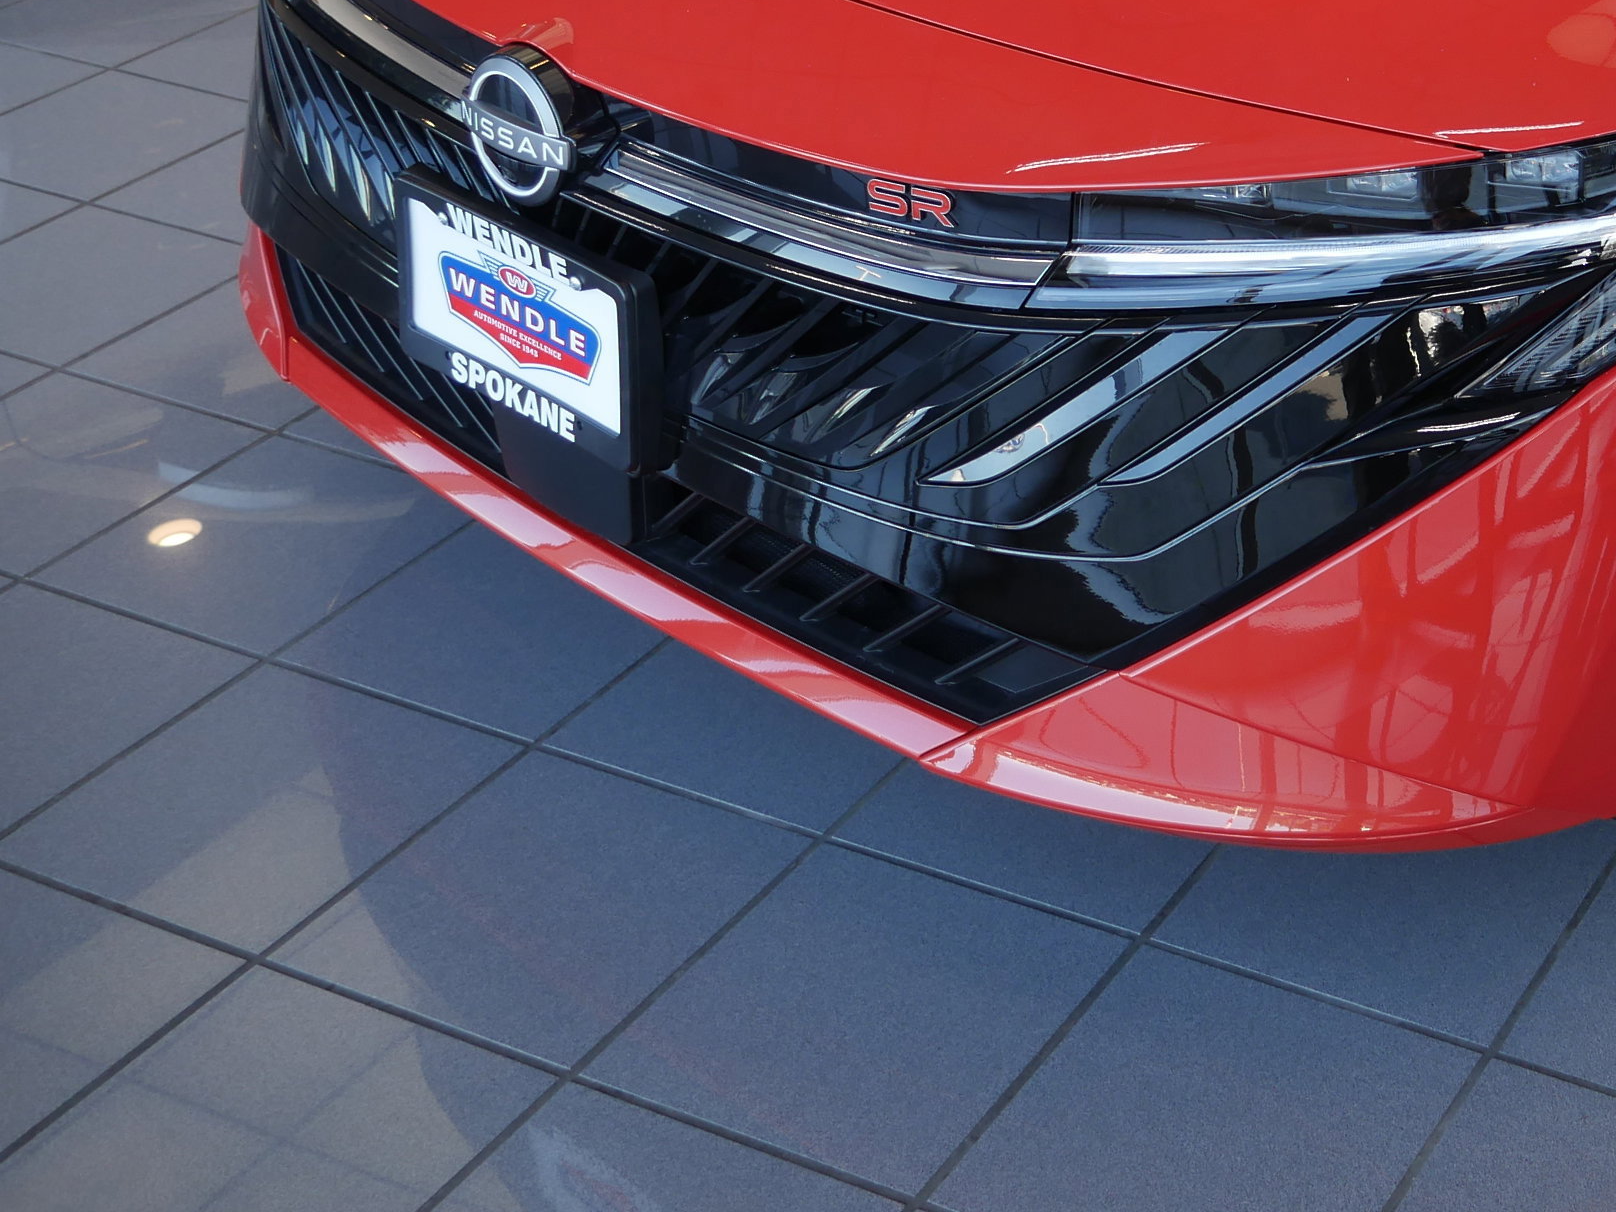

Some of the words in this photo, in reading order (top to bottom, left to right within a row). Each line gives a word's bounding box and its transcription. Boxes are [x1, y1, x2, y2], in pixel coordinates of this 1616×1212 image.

[460, 100, 565, 171] NISSAN
[866, 177, 957, 227] SR
[446, 202, 571, 282] WENDLE
[449, 267, 586, 358] WENDLE
[473, 309, 518, 338] AUTOMOTIVE
[519, 331, 562, 361] EXCELLENCE
[499, 332, 521, 350] SINCE
[522, 344, 539, 359] 1943
[450, 351, 577, 444] SPOKANE
